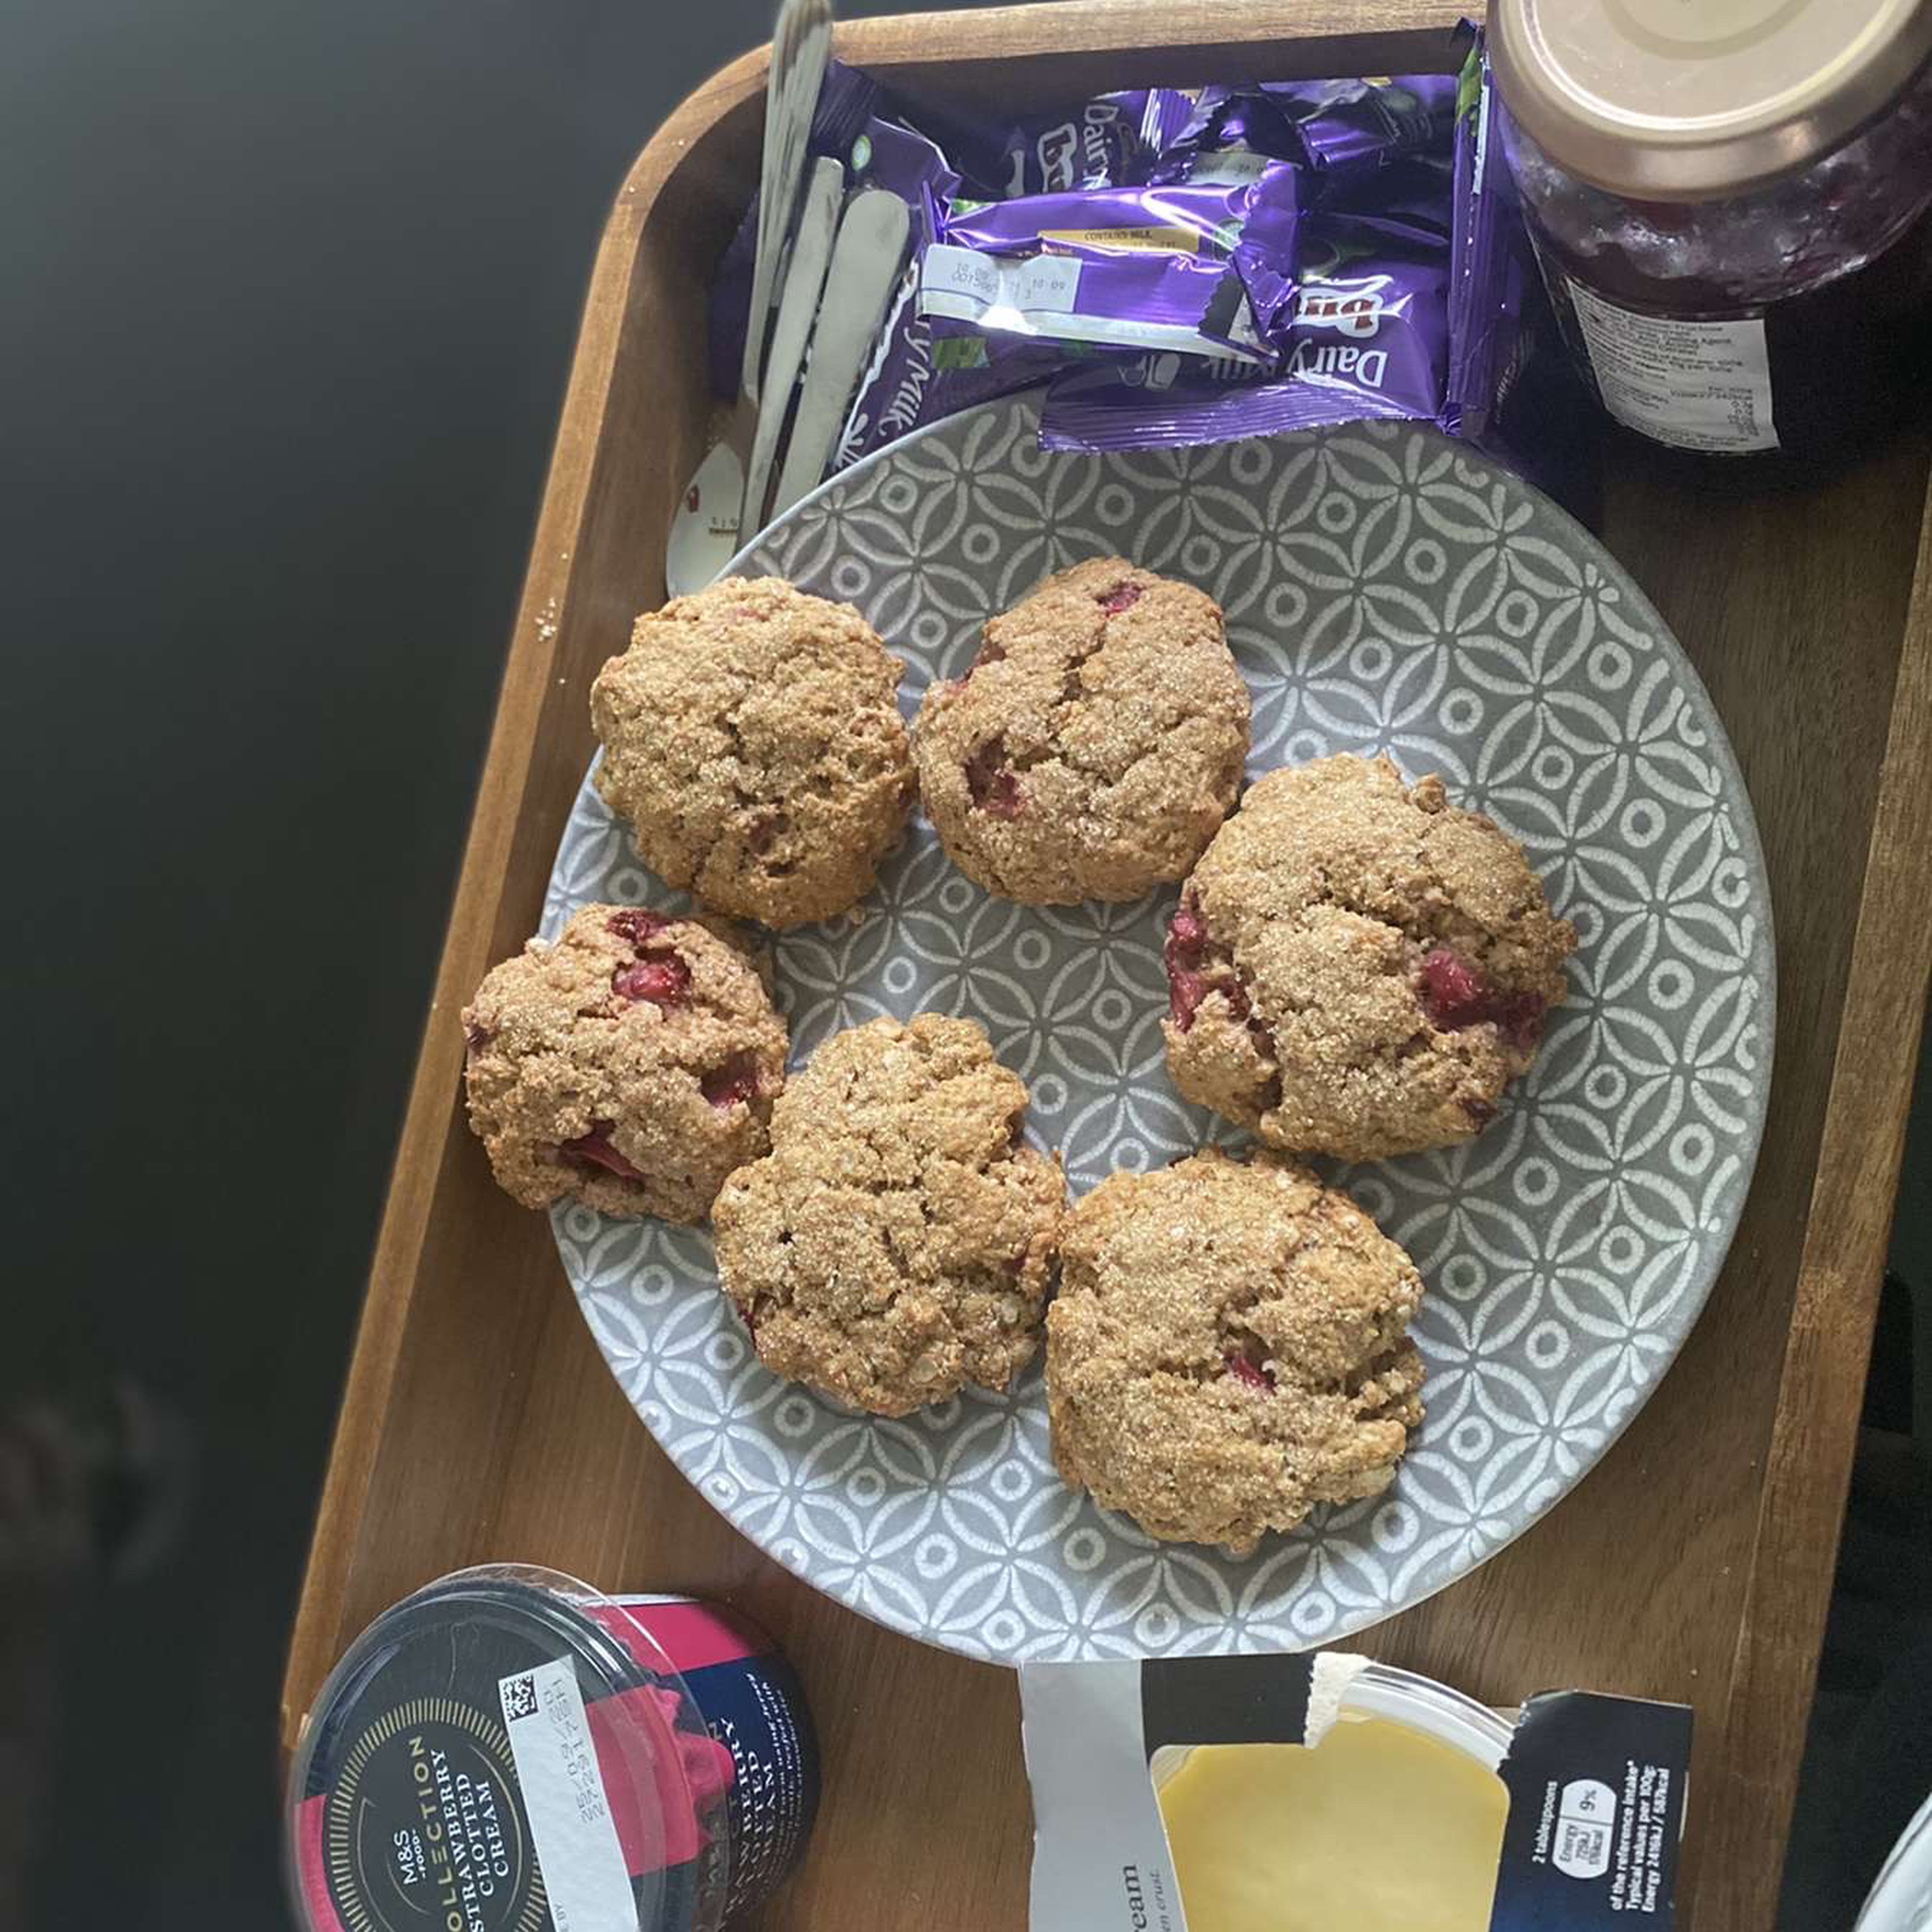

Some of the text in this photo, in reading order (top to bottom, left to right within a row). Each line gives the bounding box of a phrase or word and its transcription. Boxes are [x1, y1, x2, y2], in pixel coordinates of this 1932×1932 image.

[1287, 338, 1388, 387] Dairy
[1579, 1789, 1597, 1812] 9%
[1638, 1799, 1651, 1823] per
[430, 1748, 485, 1932] STRAWBERRY
[455, 1773, 495, 1897] CLOTTED
[474, 1780, 509, 1878] CREAM
[1532, 1781, 1558, 1865] 2 tablespoons
[1559, 1824, 1579, 1863] Energy
[1616, 1807, 1634, 1871] reference
[1633, 1824, 1648, 1865] values
[394, 1829, 419, 1885] M&S
[413, 1833, 426, 1875] FOOD
[1609, 1895, 1623, 1911] of
[1612, 1873, 1627, 1895] the
[1625, 1865, 1643, 1909] Typical
[1641, 1870, 1661, 1912] Energy
